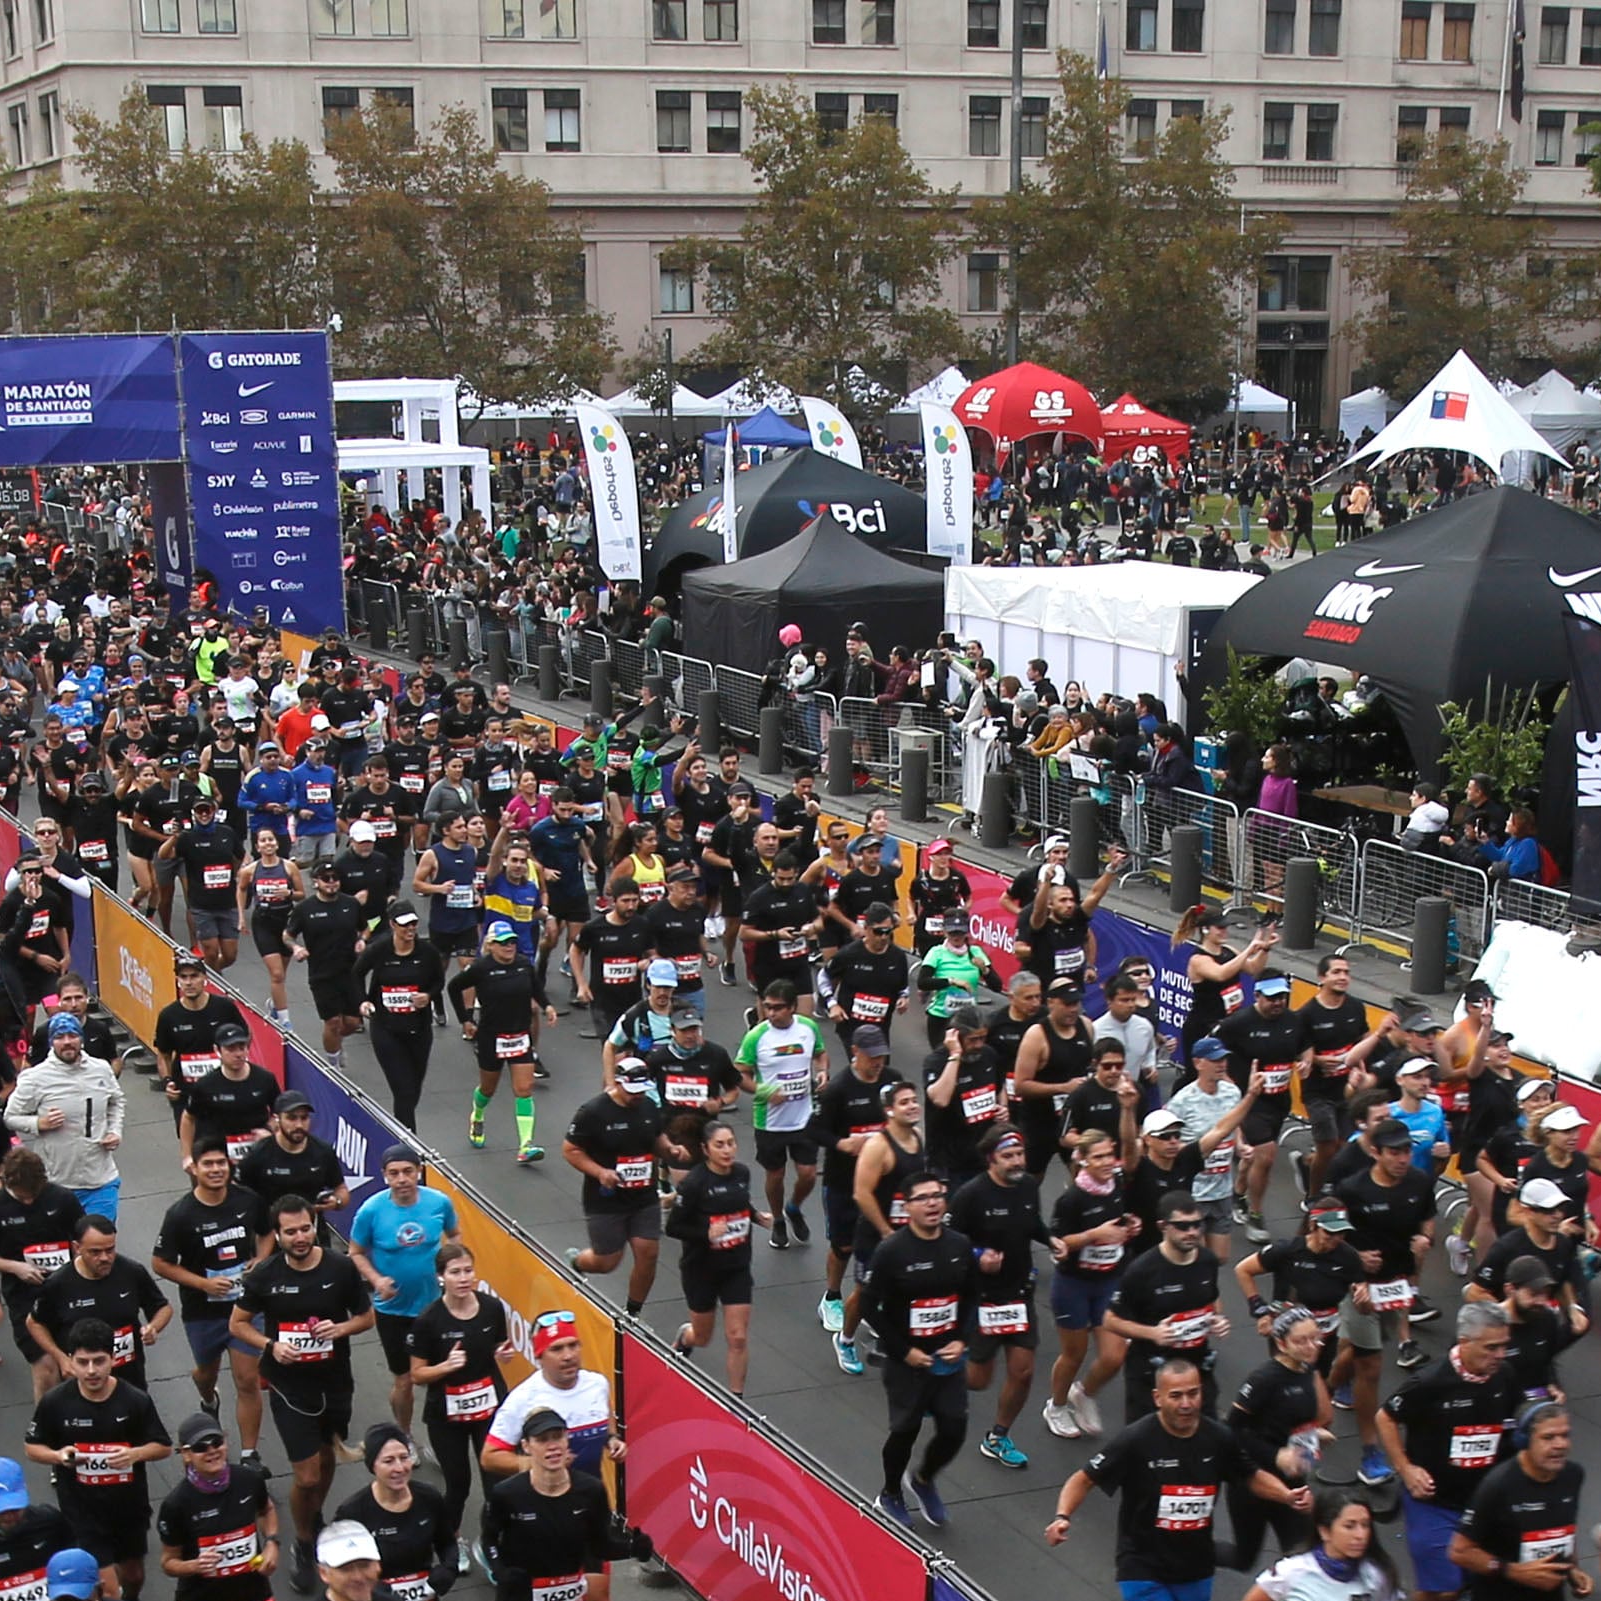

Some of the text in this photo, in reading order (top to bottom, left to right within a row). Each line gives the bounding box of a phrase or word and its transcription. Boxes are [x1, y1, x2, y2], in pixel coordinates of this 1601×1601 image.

[228, 353, 302, 366] GATORADE
[3, 381, 91, 400] MARATÓN
[5, 400, 92, 412] DE SANTIAGO
[1034, 390, 1066, 410] GS
[278, 411, 316, 420] GARMIN
[6, 481, 13, 490] K
[207, 475, 235, 488] SKY
[830, 500, 887, 535] Bci
[1315, 580, 1393, 624] NRC
[1303, 619, 1363, 645] SANTIAGO
[969, 914, 1016, 955] ChileVis
[1159, 987, 1174, 1003] DE
[1158, 1006, 1172, 1024] DE
[337, 1115, 369, 1175] RUN
[454, 1392, 489, 1411] 18377
[1169, 1500, 1208, 1516] 14701
